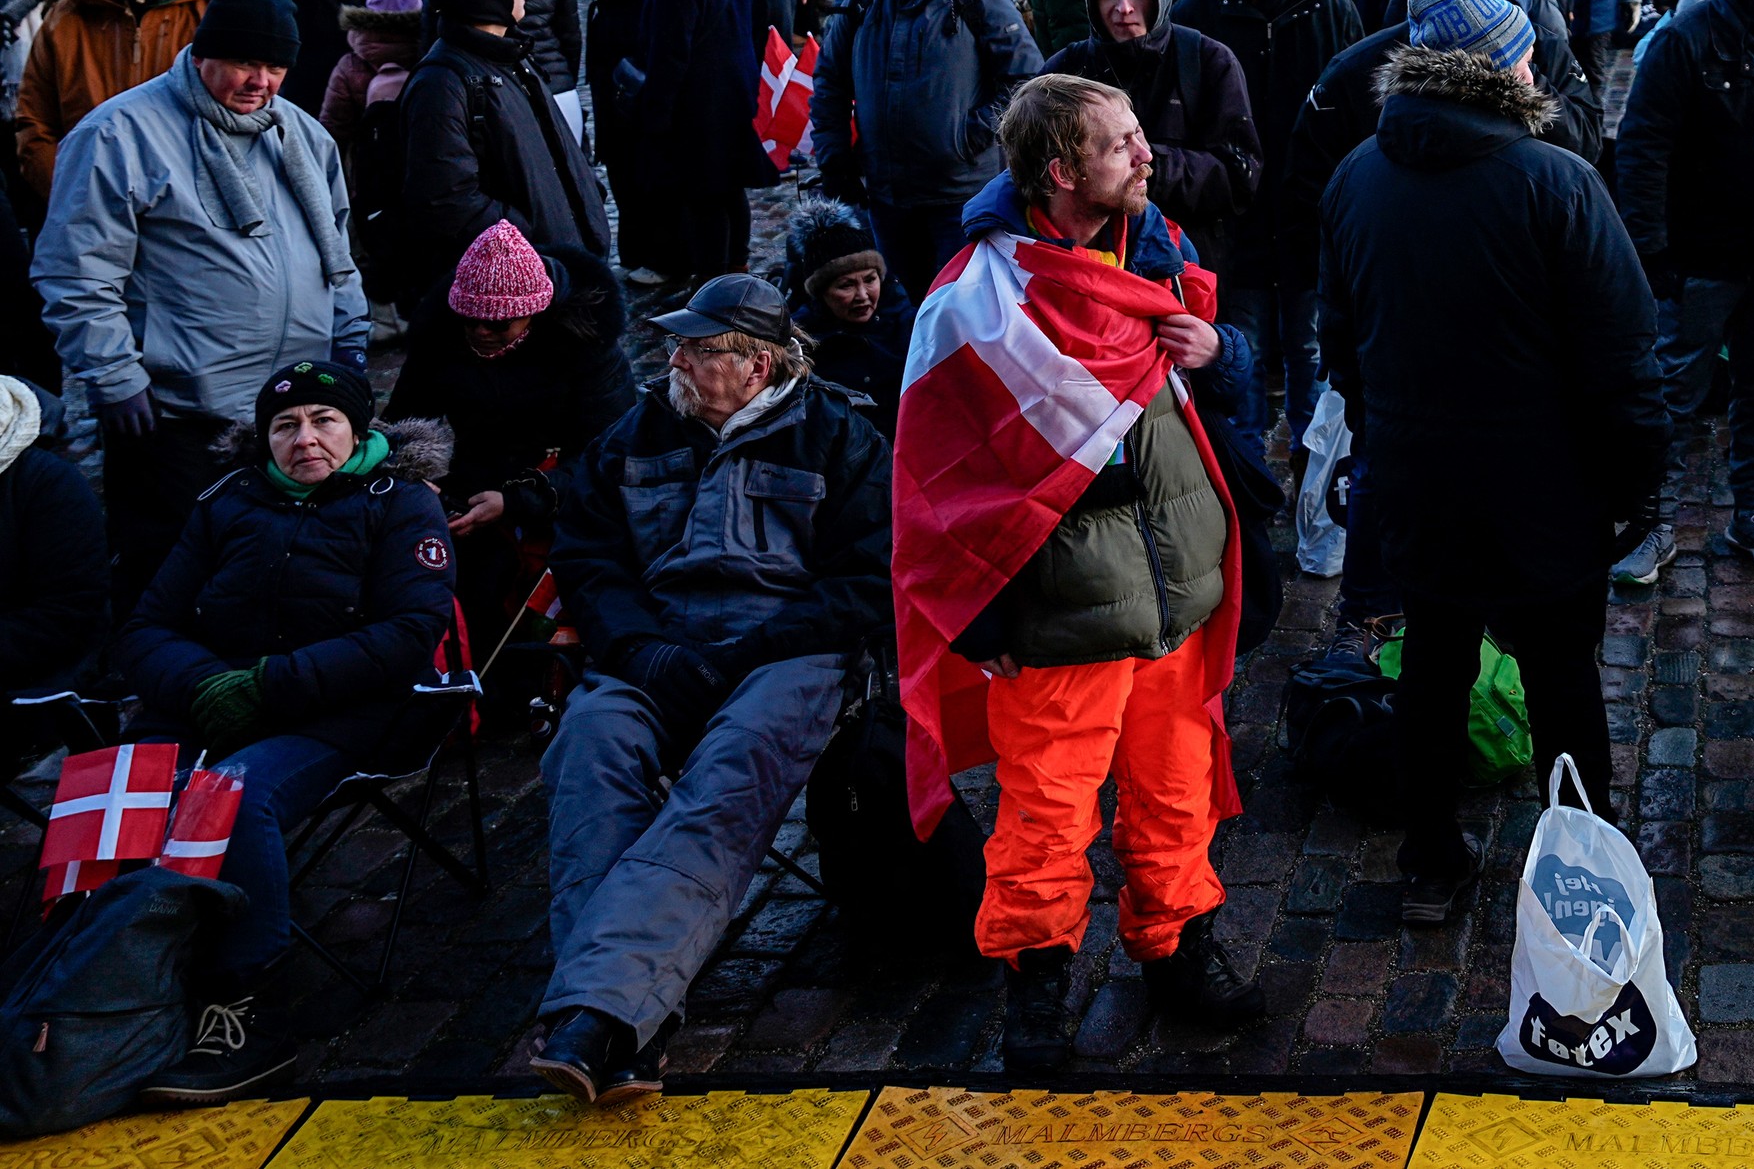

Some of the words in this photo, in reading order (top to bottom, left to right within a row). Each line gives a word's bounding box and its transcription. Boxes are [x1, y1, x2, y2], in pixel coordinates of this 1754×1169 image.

[1530, 1008, 1640, 1067] føtex
[420, 1128, 706, 1154] MALMBERGS
[992, 1123, 1274, 1145] MALMBERGS
